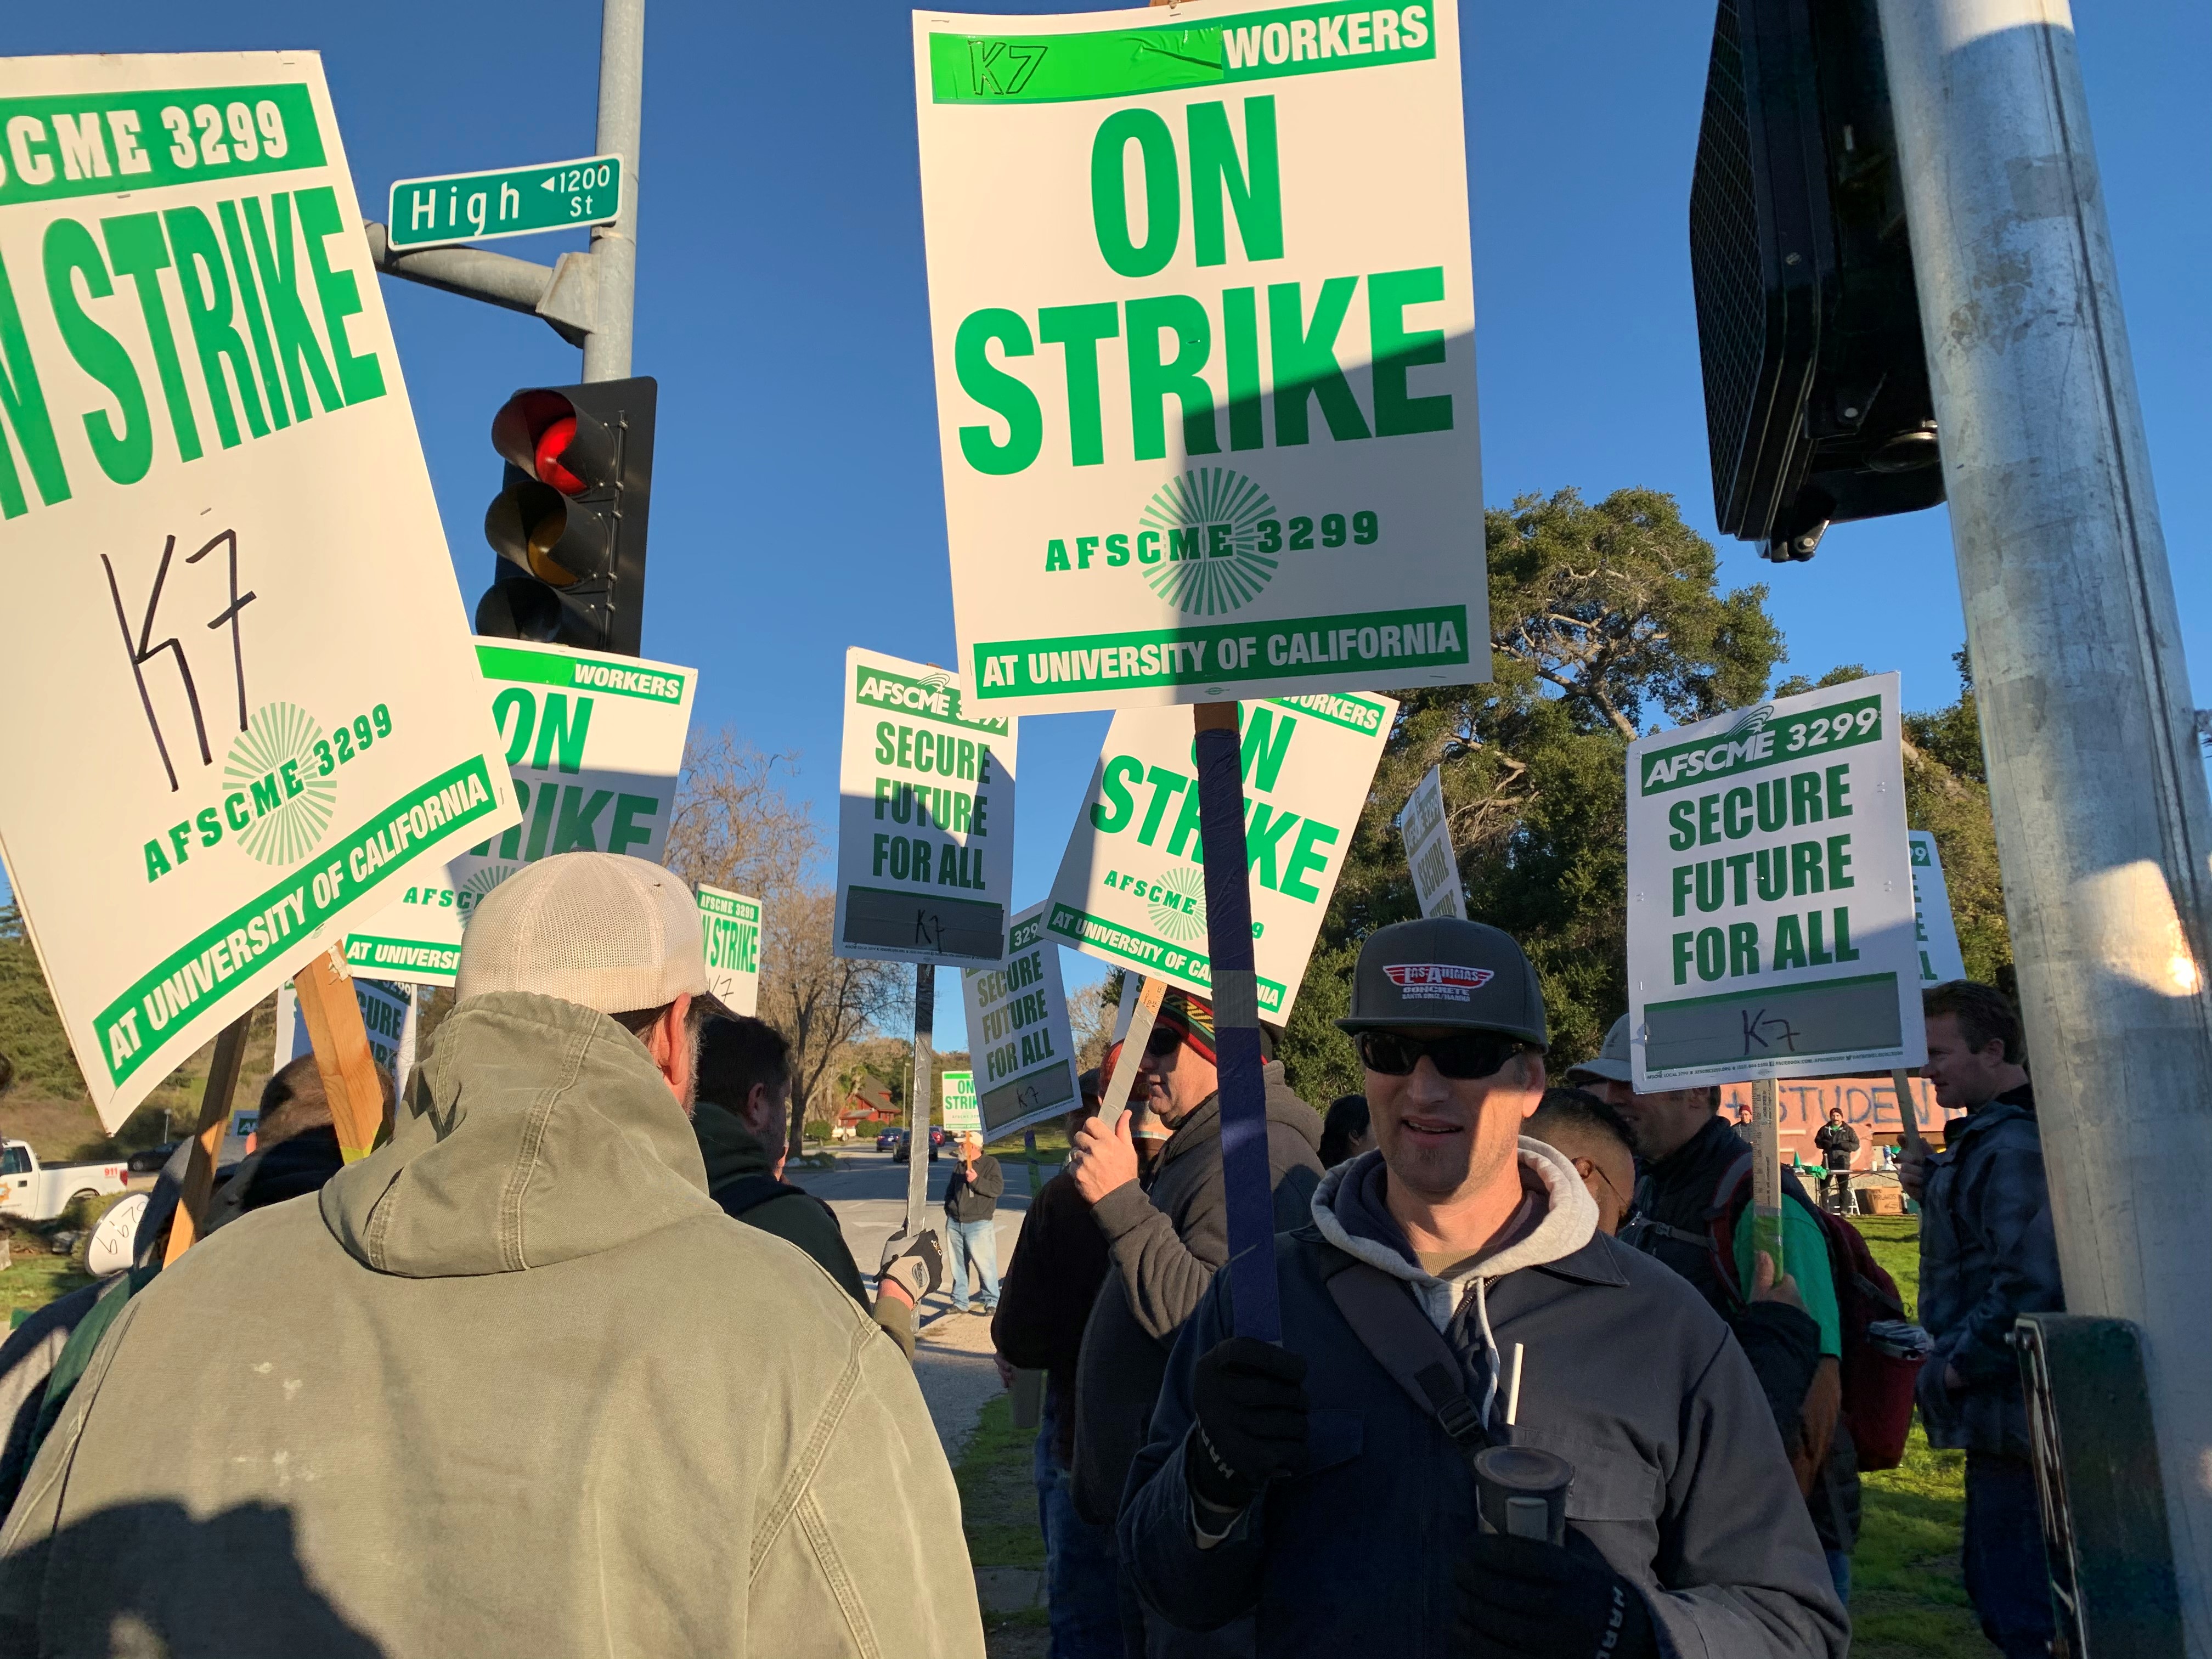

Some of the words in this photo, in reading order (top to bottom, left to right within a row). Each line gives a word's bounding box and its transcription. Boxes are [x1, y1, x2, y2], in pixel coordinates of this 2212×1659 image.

[967, 40, 1048, 96] K7
[1222, 9, 1428, 70] WORKERS
[0, 109, 153, 187] CME
[161, 100, 289, 169] 3299
[411, 182, 520, 236] High
[560, 165, 611, 193] 1200
[569, 195, 593, 218] St
[1091, 94, 1285, 278] ON
[42, 185, 387, 486] STRIKE
[954, 266, 1454, 476] STRIKE
[1045, 522, 1235, 573] AFSCME
[1257, 510, 1379, 554] 3299
[100, 528, 256, 792] K7
[574, 664, 680, 699] WORKERS
[983, 654, 1019, 687] AT
[1028, 639, 1208, 685] UNIVERSITY
[1218, 635, 1255, 670] OF
[1266, 620, 1460, 666] CALIFORNIA
[858, 676, 951, 716] AFSCME
[492, 687, 594, 775] ON
[875, 720, 991, 785] SECURE
[1644, 730, 1778, 789] AFSCME
[1785, 706, 1880, 753] 3299
[143, 756, 305, 883] AFSCME
[312, 703, 393, 777] 3299
[874, 776, 988, 838] FUTURE
[1668, 763, 1854, 852] SECURE
[873, 833, 932, 882] FOR
[939, 844, 986, 890] ALL
[1672, 833, 1855, 918] FUTURE
[109, 1008, 142, 1070] AT
[144, 884, 309, 1032] UNIVERSITY
[312, 861, 344, 912] OF
[348, 771, 489, 882] CALIFORNIA
[403, 886, 484, 910] AFSC
[701, 894, 733, 915] AFSCME
[735, 904, 754, 920] 3299
[1103, 869, 1198, 916] AFSCME
[346, 941, 373, 961] AT
[710, 917, 759, 974] STRIKE
[915, 909, 945, 955] K7
[1052, 911, 1075, 930] AT
[1075, 919, 1165, 963] UNIVERSITY
[1165, 951, 1188, 970] OF
[1672, 921, 1760, 986] FOR
[1773, 906, 1860, 972] ALL
[977, 950, 1043, 1008] SECURE
[1403, 986, 1470, 996] CONCRETE
[1404, 967, 1426, 984] LAS
[982, 988, 1049, 1045] FUTURE
[1741, 1008, 1801, 1056] K7
[986, 1042, 1019, 1082] FOR
[1022, 1027, 1054, 1067] ALL
[957, 1080, 974, 1094] ON
[1016, 1086, 1039, 1109] K7
[104, 1167, 118, 1176] 911
